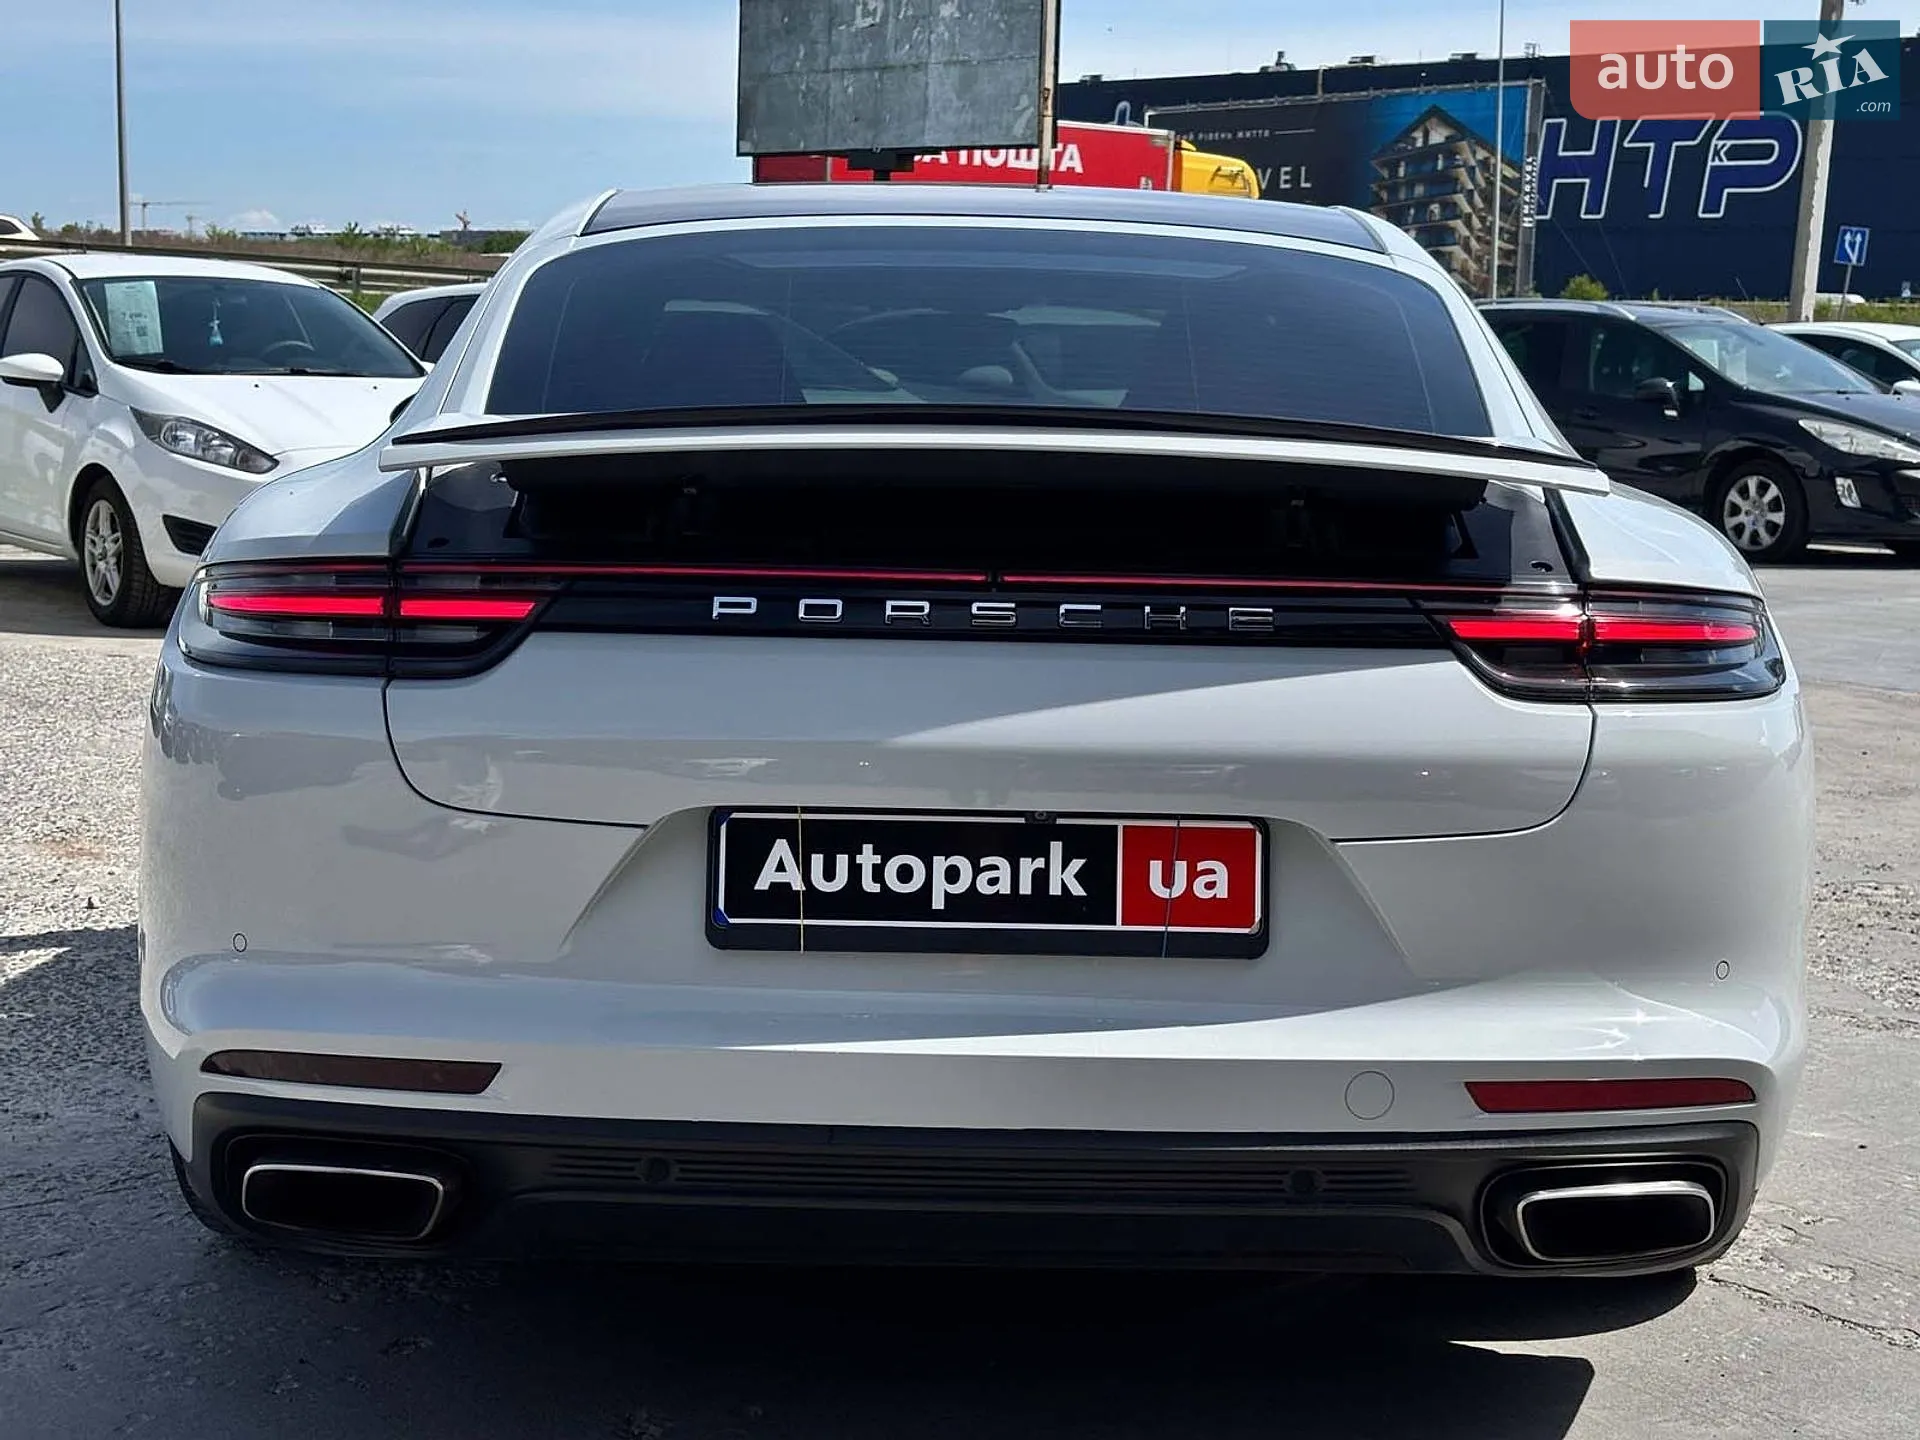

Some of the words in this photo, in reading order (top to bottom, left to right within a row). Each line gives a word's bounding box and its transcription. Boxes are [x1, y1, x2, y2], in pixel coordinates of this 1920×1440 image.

[712, 596, 1275, 632] PORSCHE
[754, 838, 1087, 910] Autopark
[1149, 857, 1229, 899] ua
